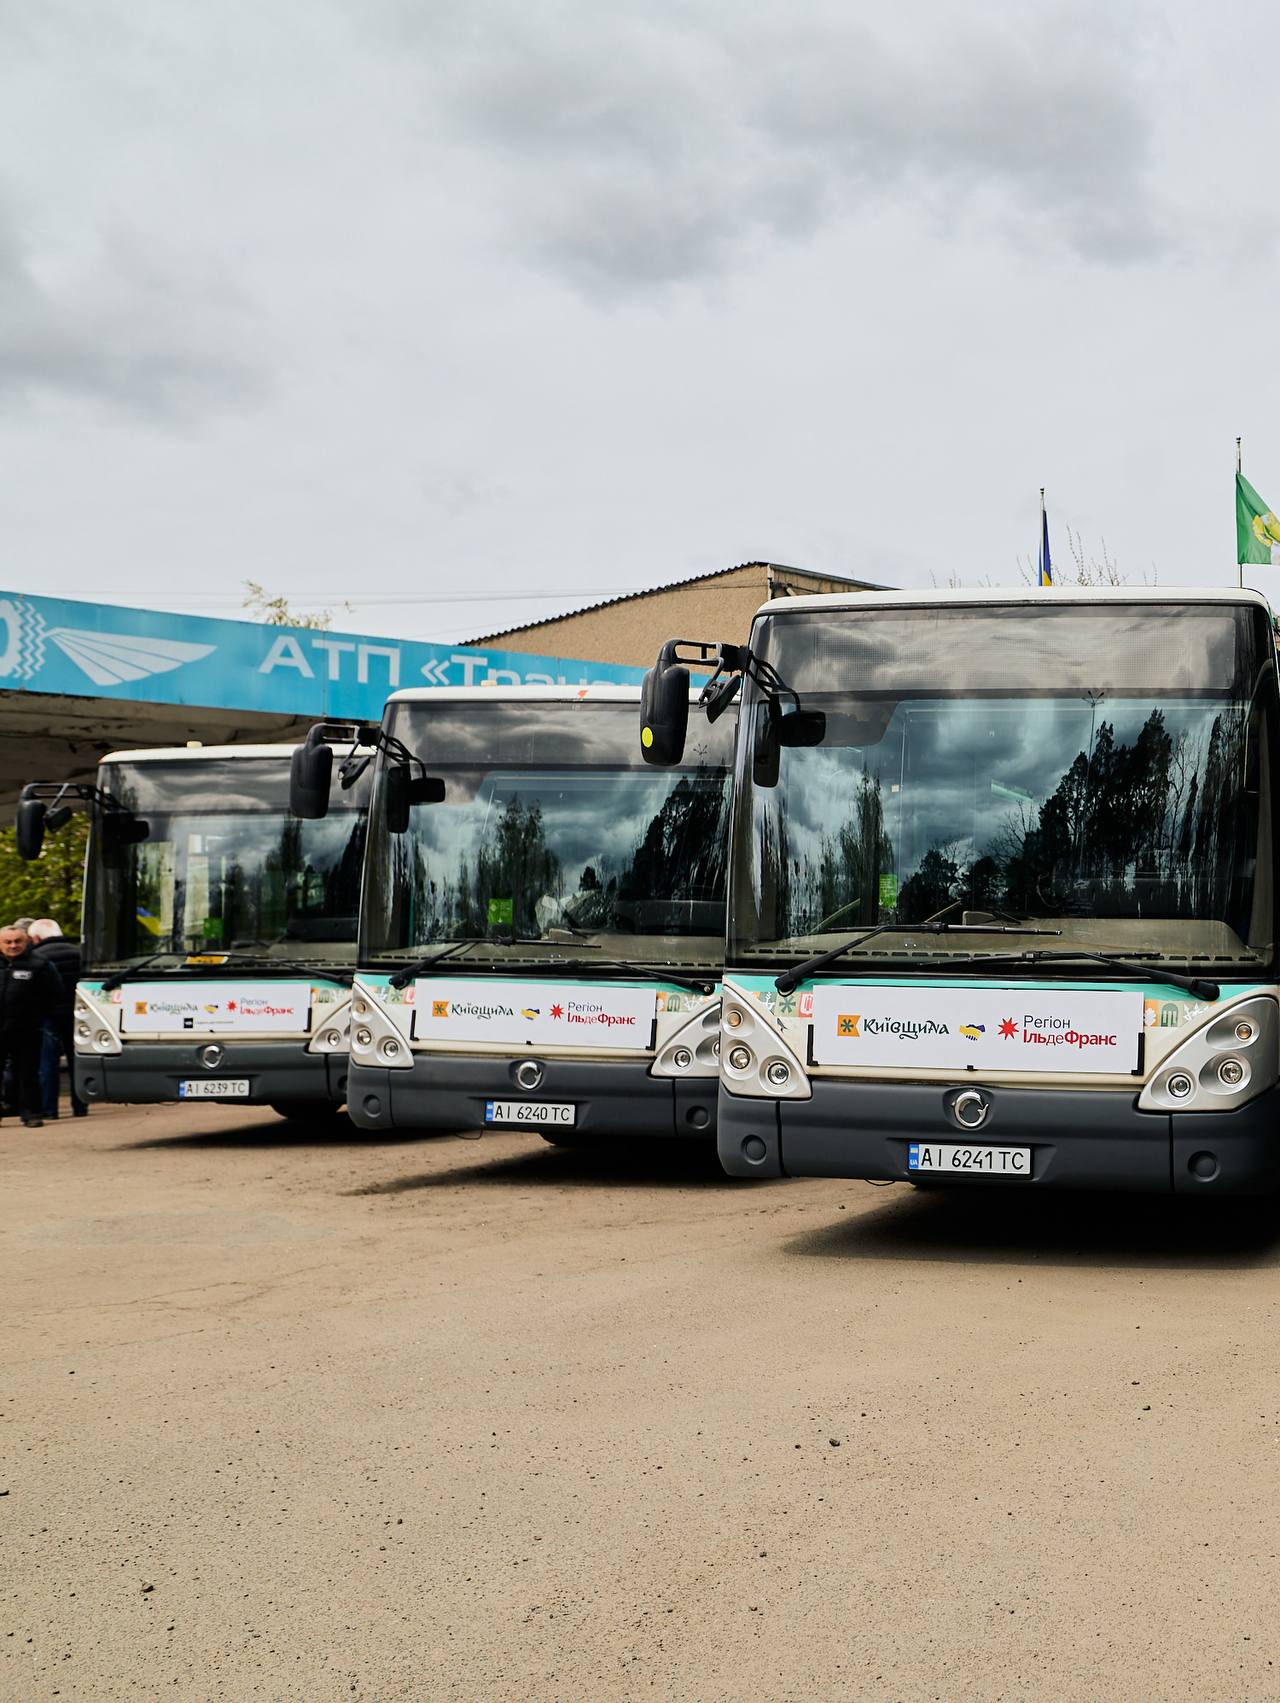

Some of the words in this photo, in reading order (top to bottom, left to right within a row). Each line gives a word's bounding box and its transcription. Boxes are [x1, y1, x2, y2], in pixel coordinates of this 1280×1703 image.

[258, 635, 400, 687] АТП
[568, 1001, 603, 1012] Регіон
[567, 1012, 636, 1027] ІльдеФранс
[1023, 1015, 1071, 1029] Регіон
[863, 1017, 950, 1040] Київщина
[1023, 1029, 1117, 1049] ІльдеФранс
[517, 1106, 548, 1120] 6240
[551, 1107, 570, 1121] TC
[952, 1149, 993, 1169] 6241
[998, 1151, 1024, 1170] TC
